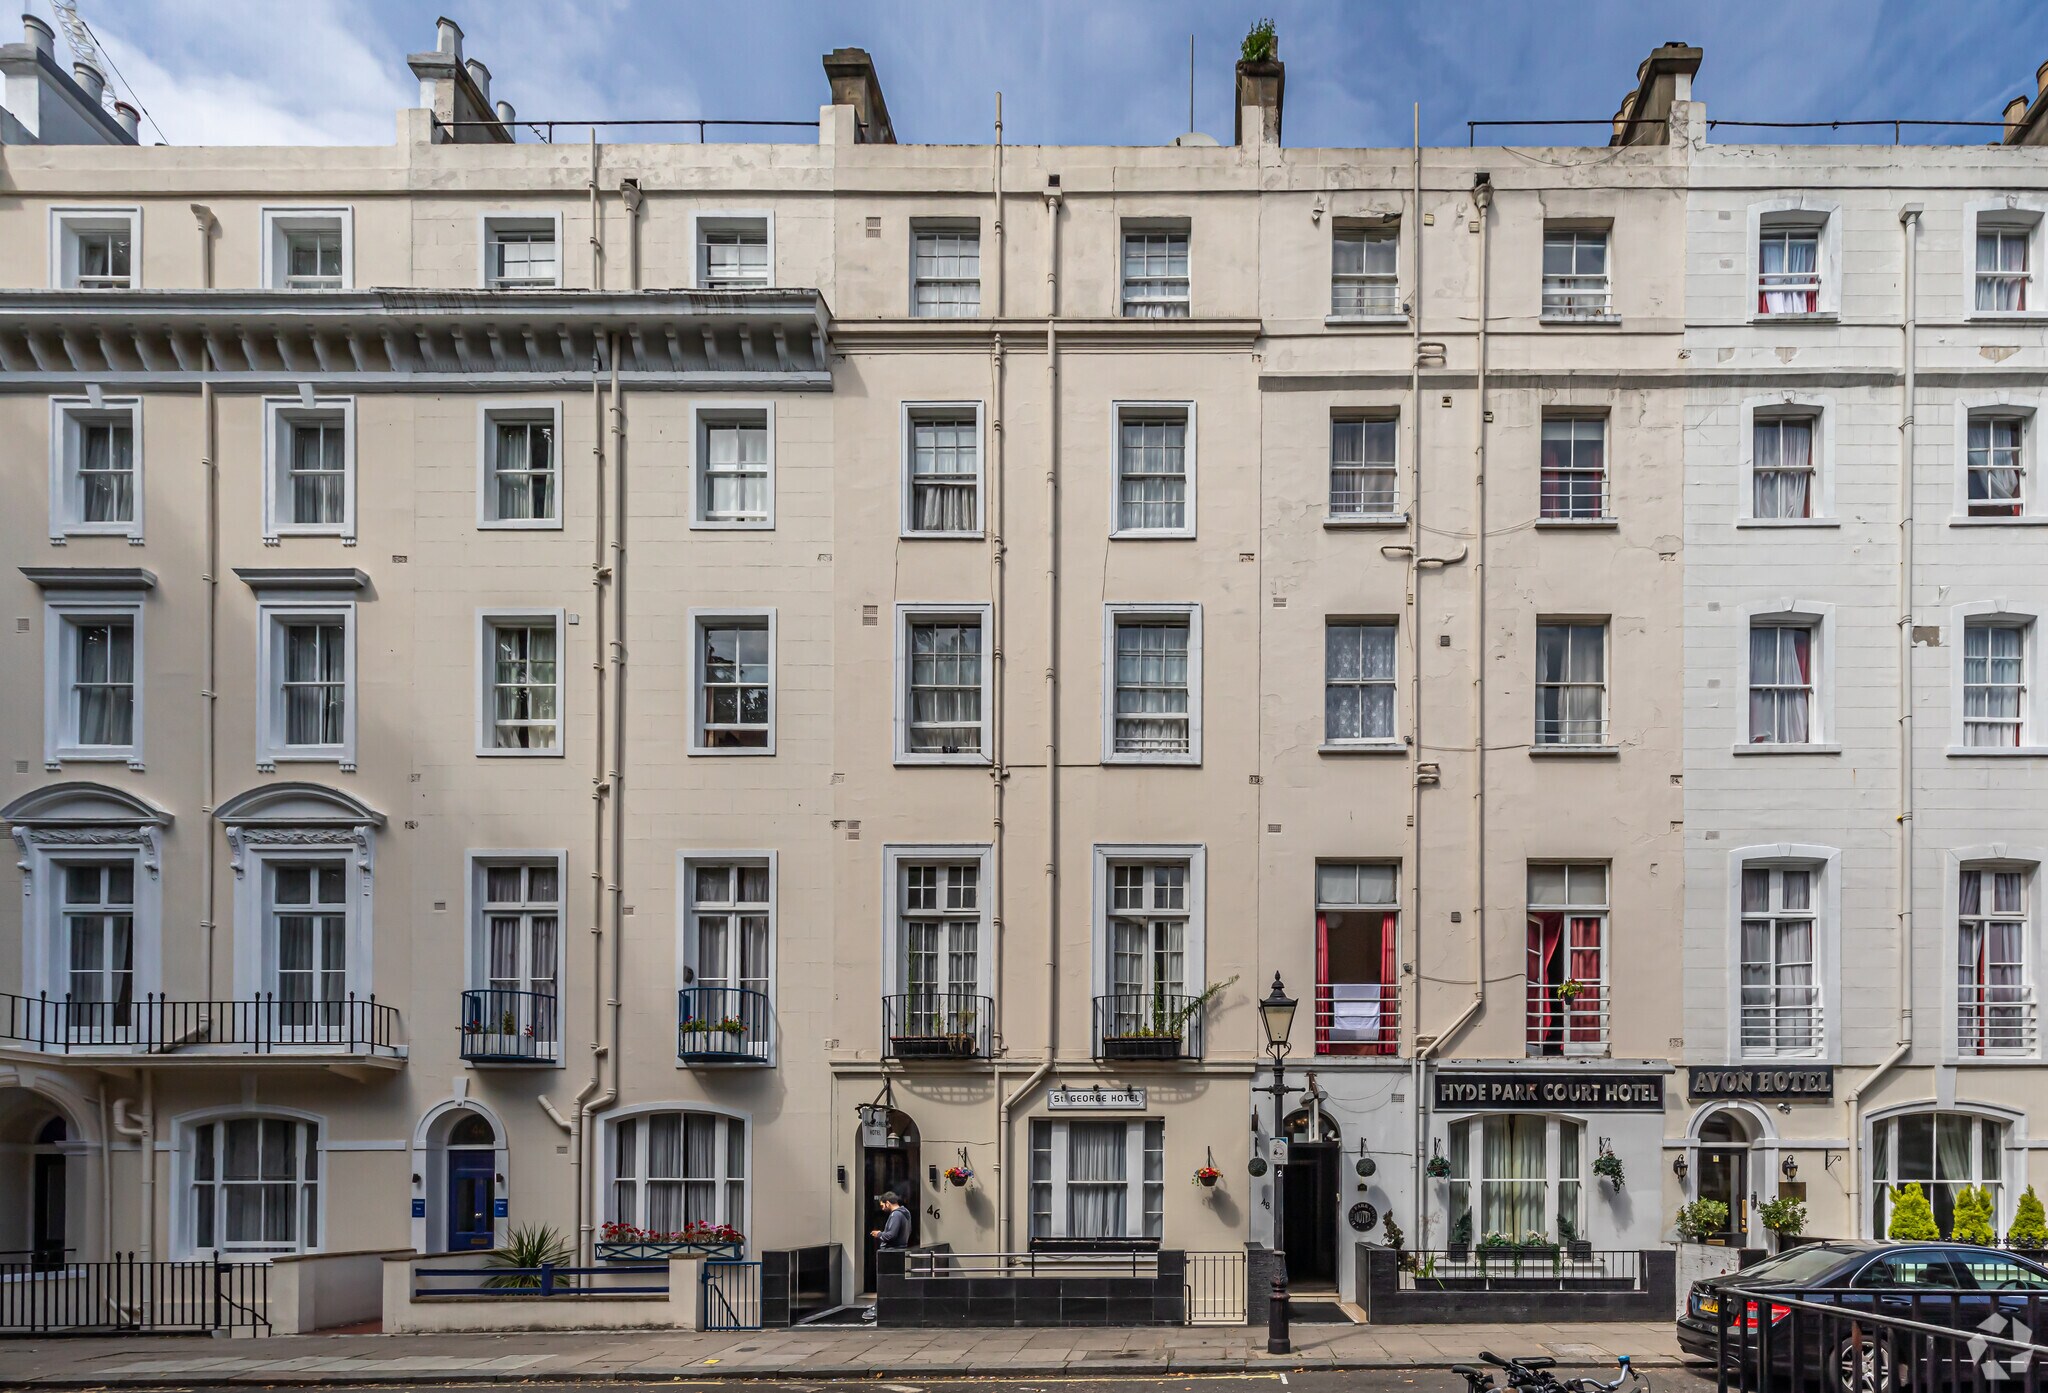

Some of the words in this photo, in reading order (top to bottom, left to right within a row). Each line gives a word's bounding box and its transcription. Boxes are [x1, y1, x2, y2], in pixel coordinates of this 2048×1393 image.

[1693, 1071, 1753, 1093] AVON
[1756, 1071, 1831, 1093] HOTEL
[1070, 1094, 1107, 1103] GEORGE
[1111, 1094, 1140, 1102] HOTEL
[1441, 1083, 1487, 1101] HYDE
[1491, 1083, 1538, 1101] PARK
[1543, 1083, 1601, 1102] COURT
[1605, 1083, 1659, 1102] HOTEL
[1276, 1169, 1283, 1178] 2
[1260, 1198, 1271, 1210] 48
[926, 1204, 941, 1220] 46
